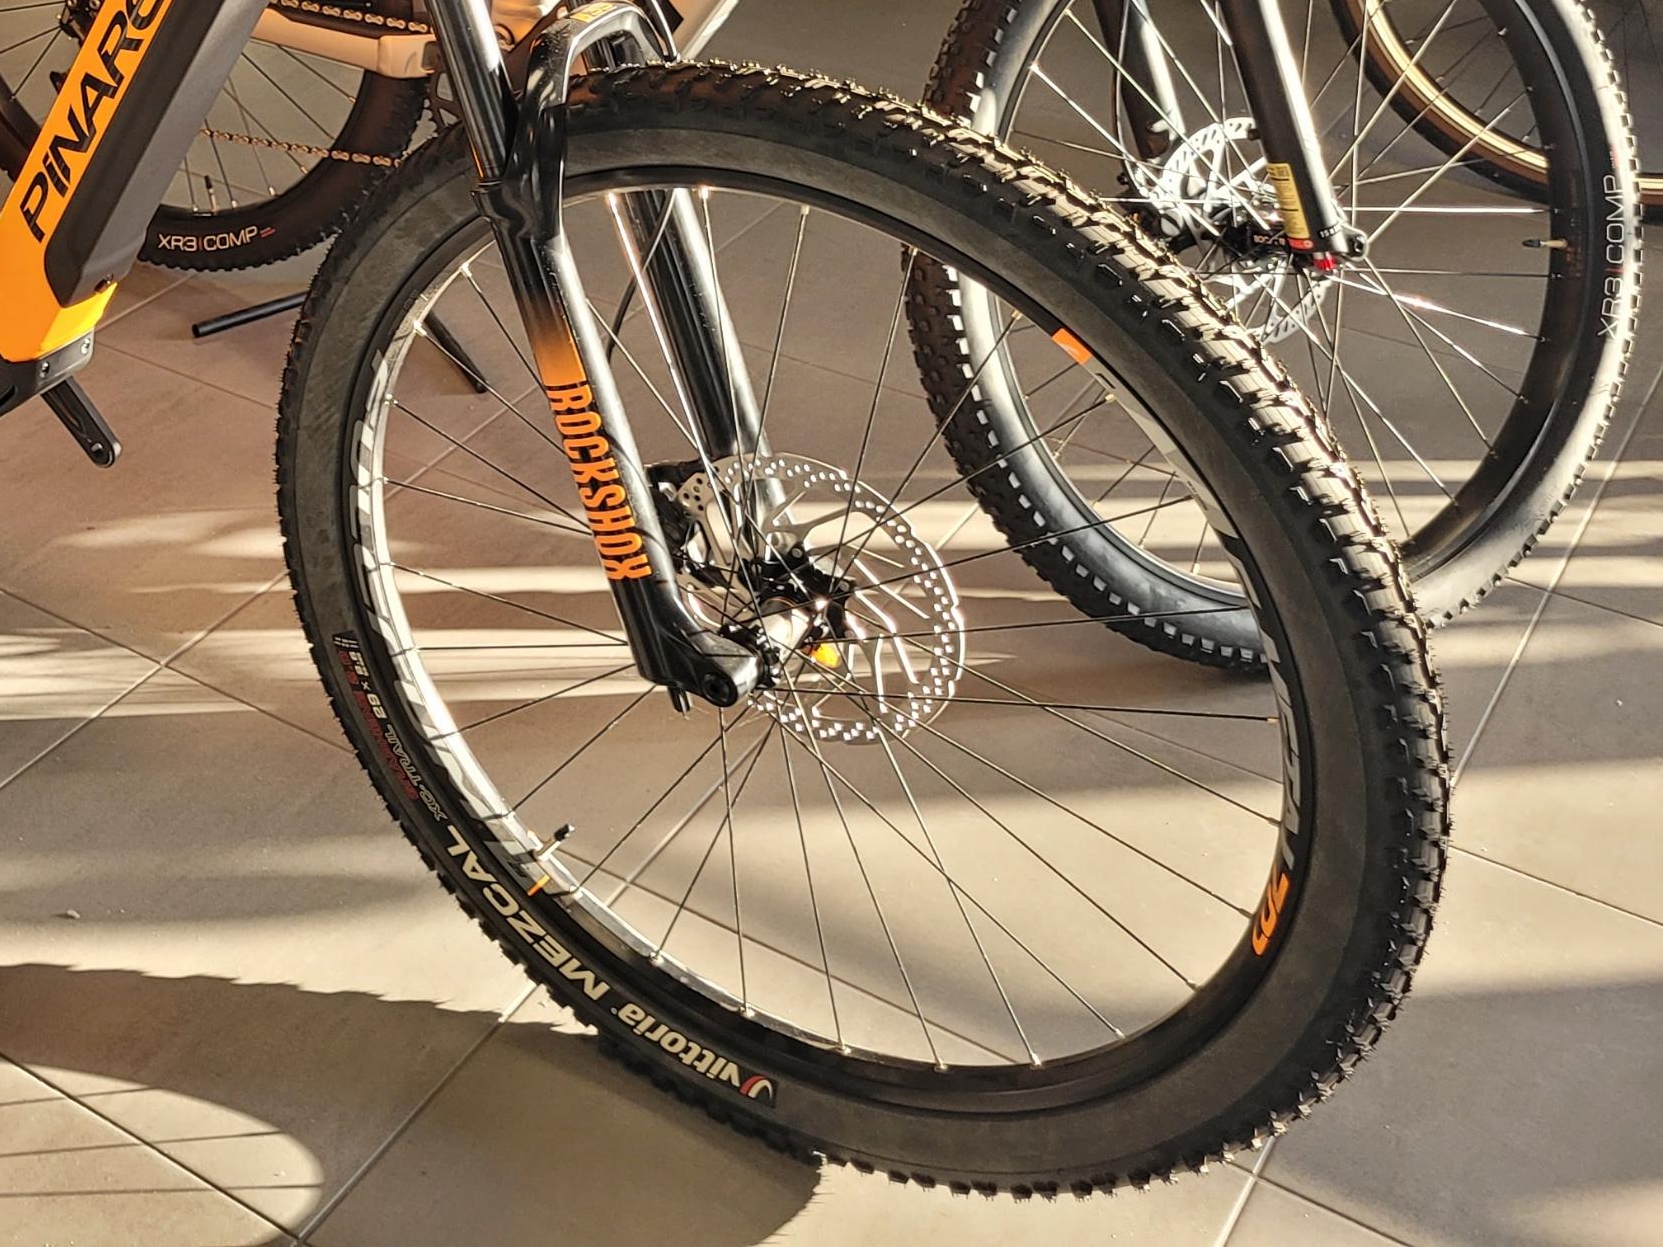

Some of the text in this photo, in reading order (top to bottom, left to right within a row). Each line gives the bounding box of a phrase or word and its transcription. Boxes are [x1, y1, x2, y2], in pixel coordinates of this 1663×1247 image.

[158, 225, 259, 252] XR3 COMP
[1603, 174, 1625, 265] COMP
[545, 382, 653, 581] ROCKSHOX
[448, 822, 611, 1001] MEZCAL
